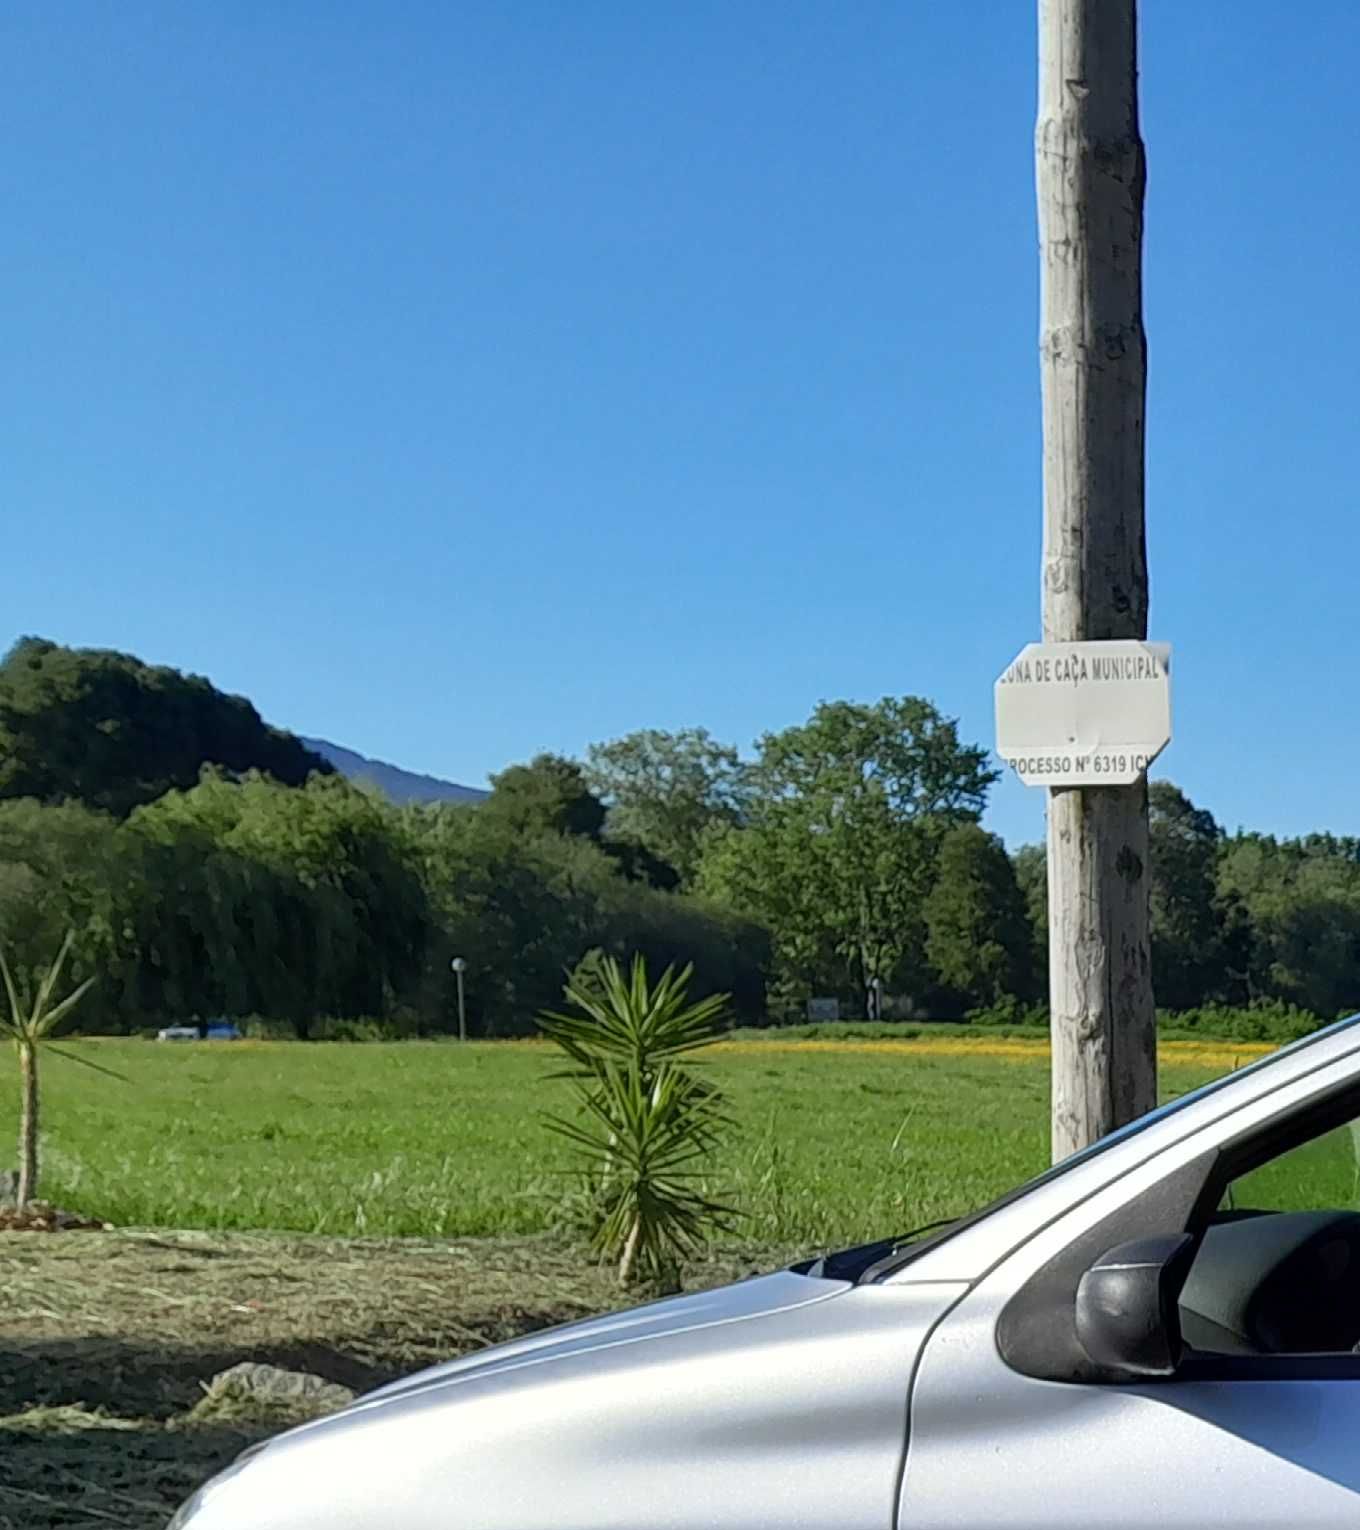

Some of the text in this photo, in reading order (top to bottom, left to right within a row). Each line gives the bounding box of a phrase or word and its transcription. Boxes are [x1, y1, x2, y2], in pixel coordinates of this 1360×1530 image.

[999, 656, 1159, 687] ONA DE CAÇA MUNICIPAL
[1093, 754, 1127, 773] 6319
